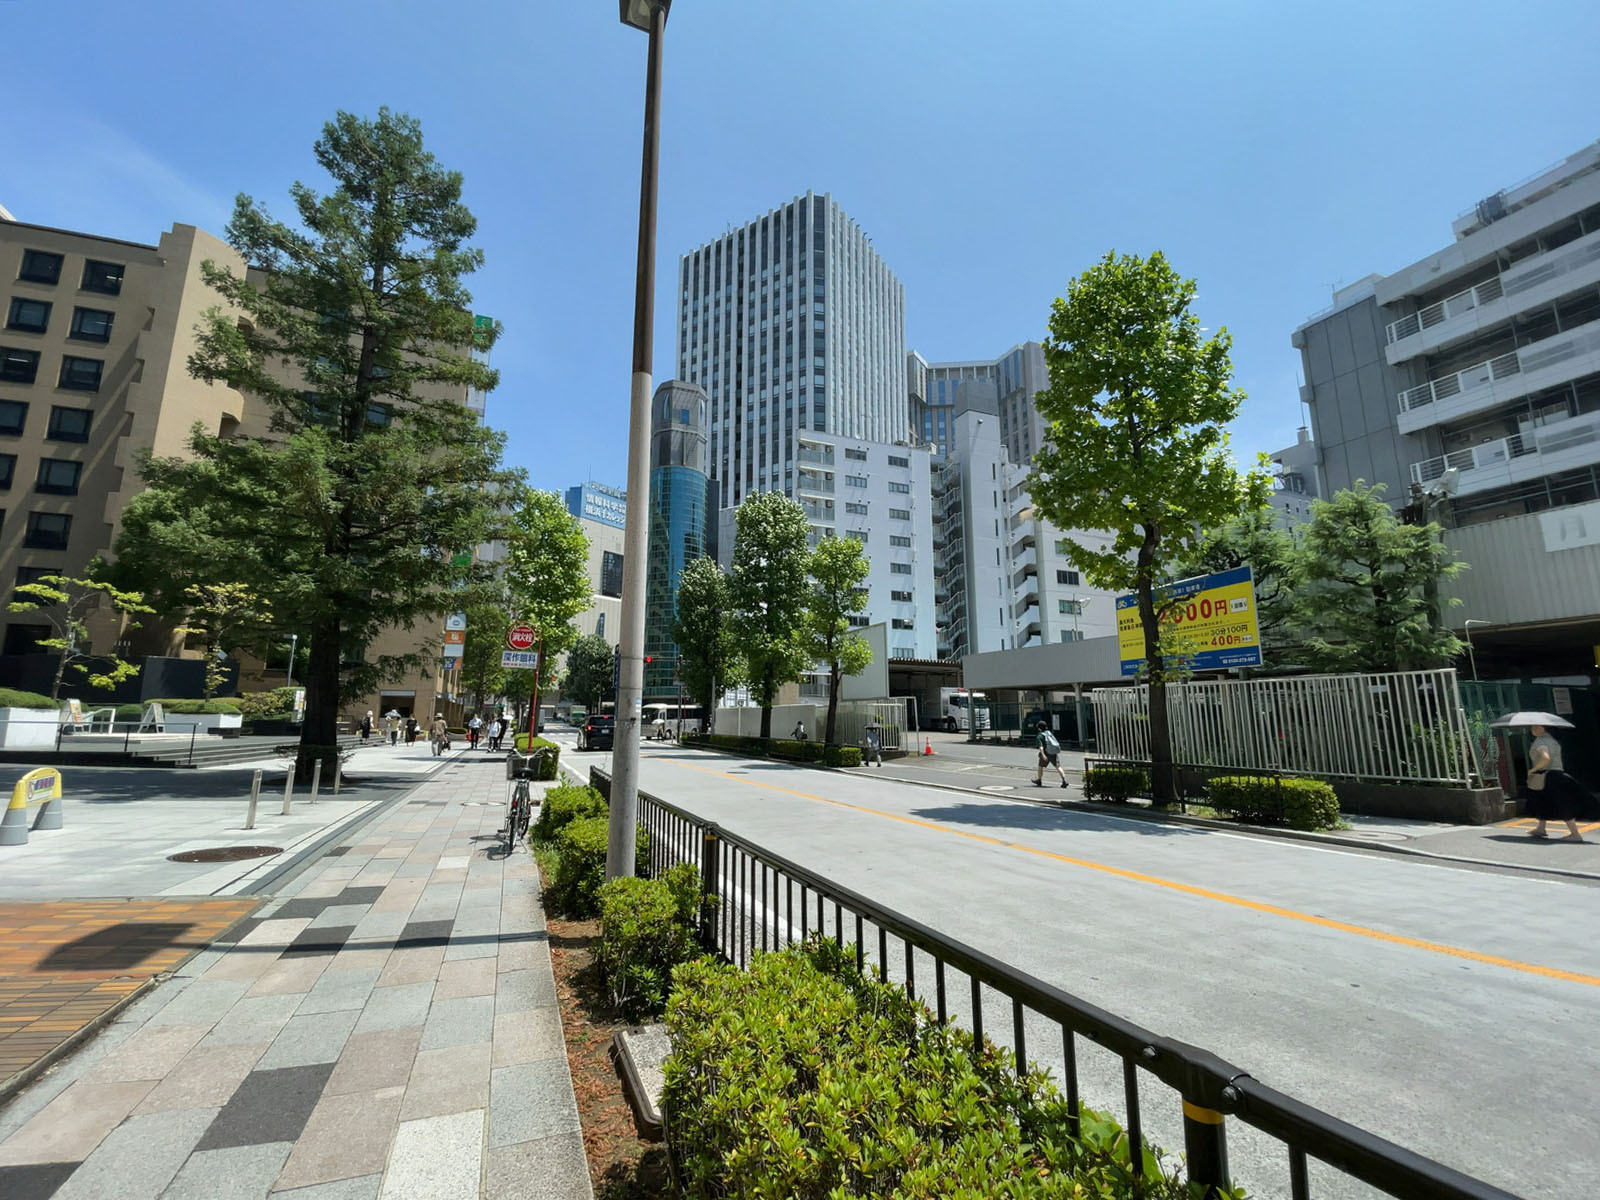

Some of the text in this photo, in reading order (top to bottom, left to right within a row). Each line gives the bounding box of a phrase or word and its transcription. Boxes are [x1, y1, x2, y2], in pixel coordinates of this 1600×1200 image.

[512, 633, 533, 642] 消火栓
[1211, 635, 1240, 646] 400円
[504, 652, 536, 663] 深作眼科
